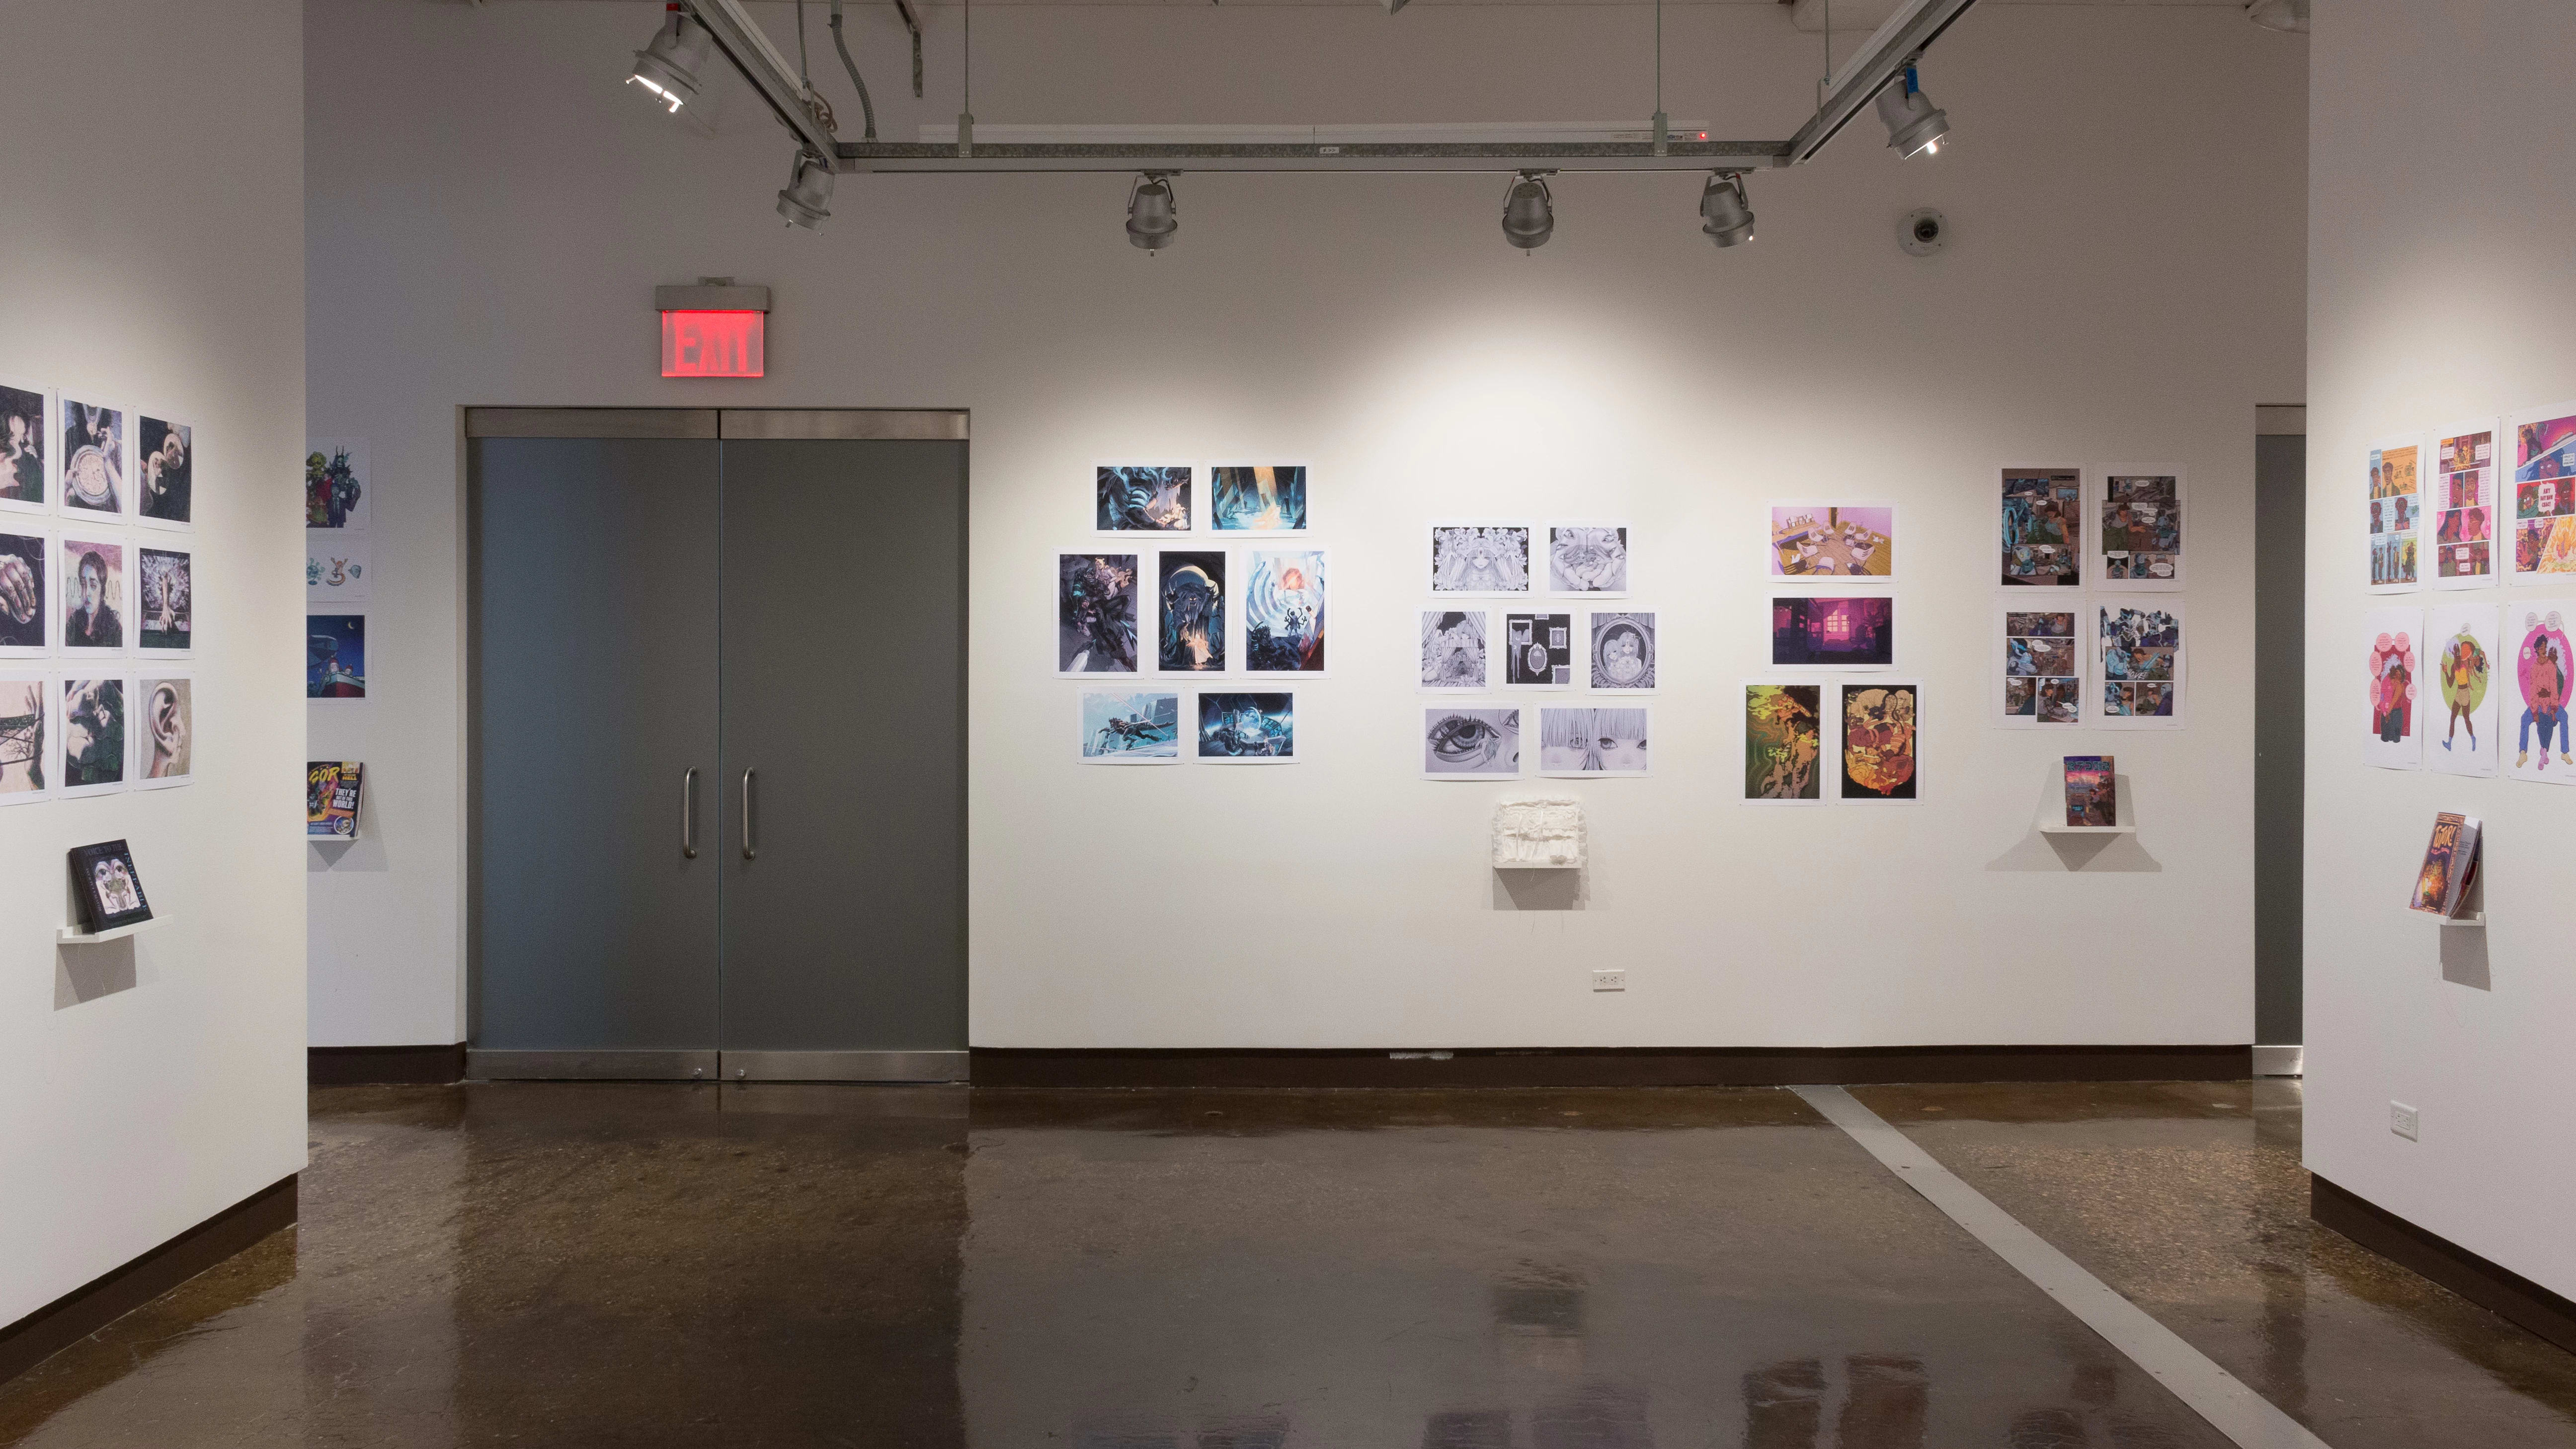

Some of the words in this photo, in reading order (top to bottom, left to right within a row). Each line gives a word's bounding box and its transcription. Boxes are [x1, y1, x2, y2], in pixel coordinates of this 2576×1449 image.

[675, 315, 753, 372] EXIT
[335, 788, 357, 798] THEY'RE
[333, 799, 355, 809] WORLD!
